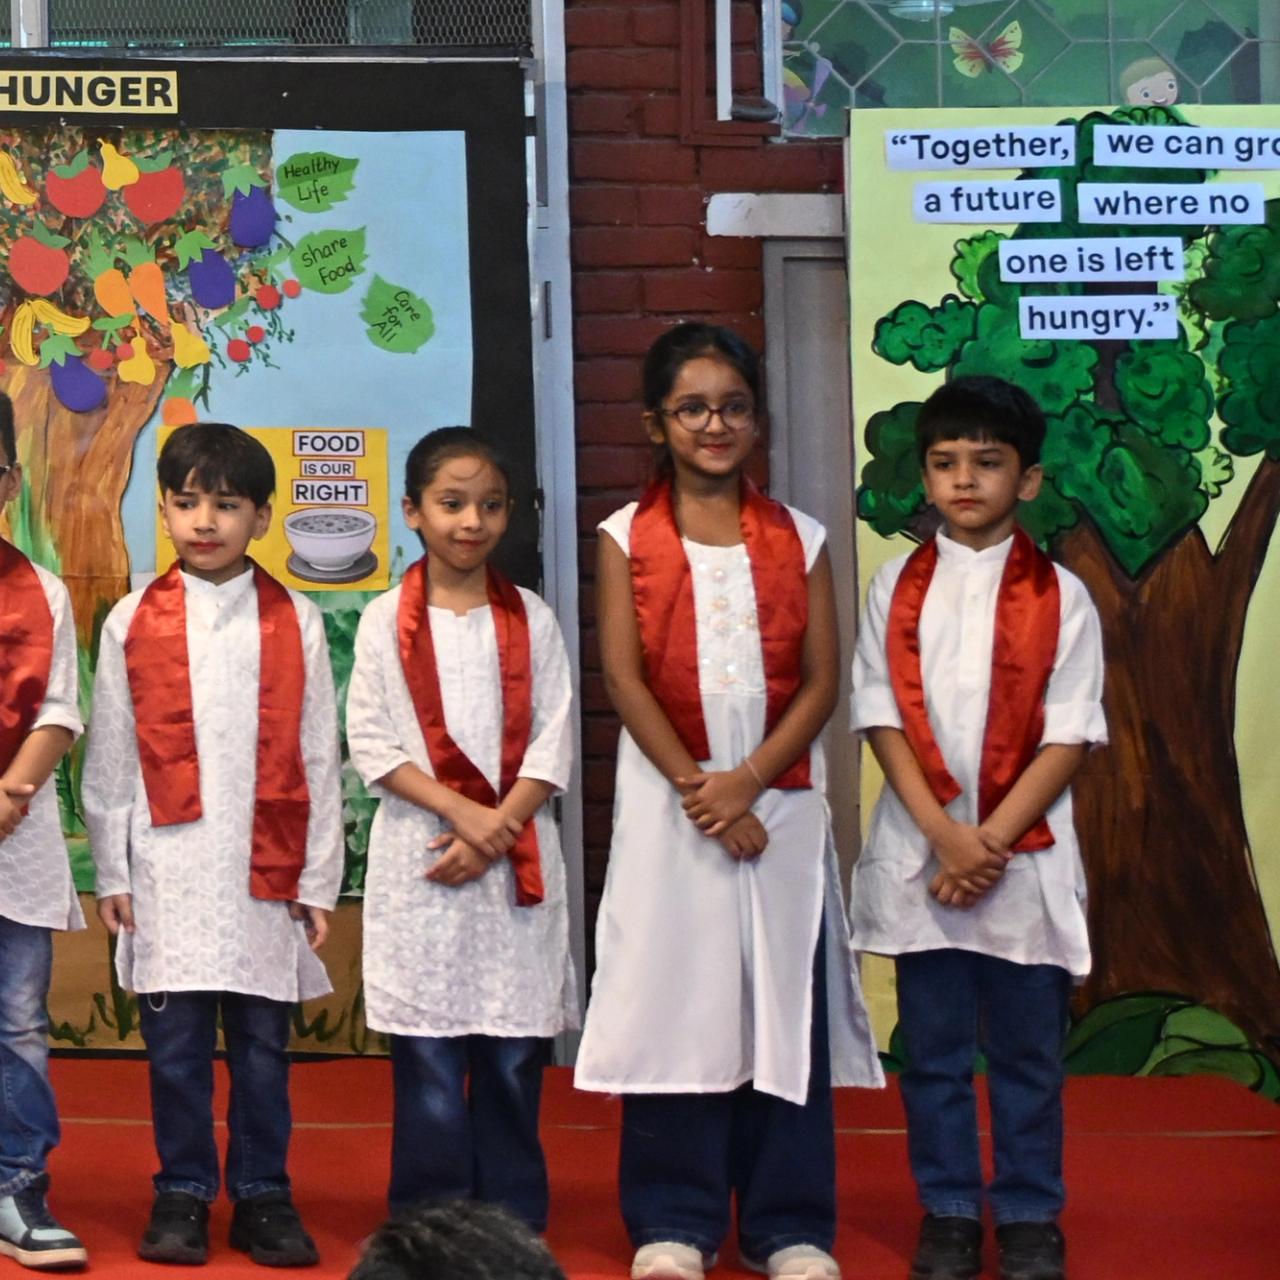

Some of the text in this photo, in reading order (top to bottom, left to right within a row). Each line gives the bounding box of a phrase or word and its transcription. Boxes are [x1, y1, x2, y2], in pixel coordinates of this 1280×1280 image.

[891, 132, 1070, 165] “Together,
[1107, 132, 1154, 154] we
[1164, 134, 1224, 155] can
[284, 157, 341, 179] Healthy
[297, 179, 330, 204] Life
[923, 186, 1250, 216] a future where no
[318, 255, 357, 286] Food
[1005, 245, 1175, 275] one is left
[382, 306, 403, 328] for
[394, 291, 421, 322] Care
[1028, 301, 1170, 335] hungry.”
[371, 322, 398, 342] All
[298, 435, 360, 452] FOOD
[303, 463, 352, 475] IS OUR
[295, 484, 363, 502] RIGHT
